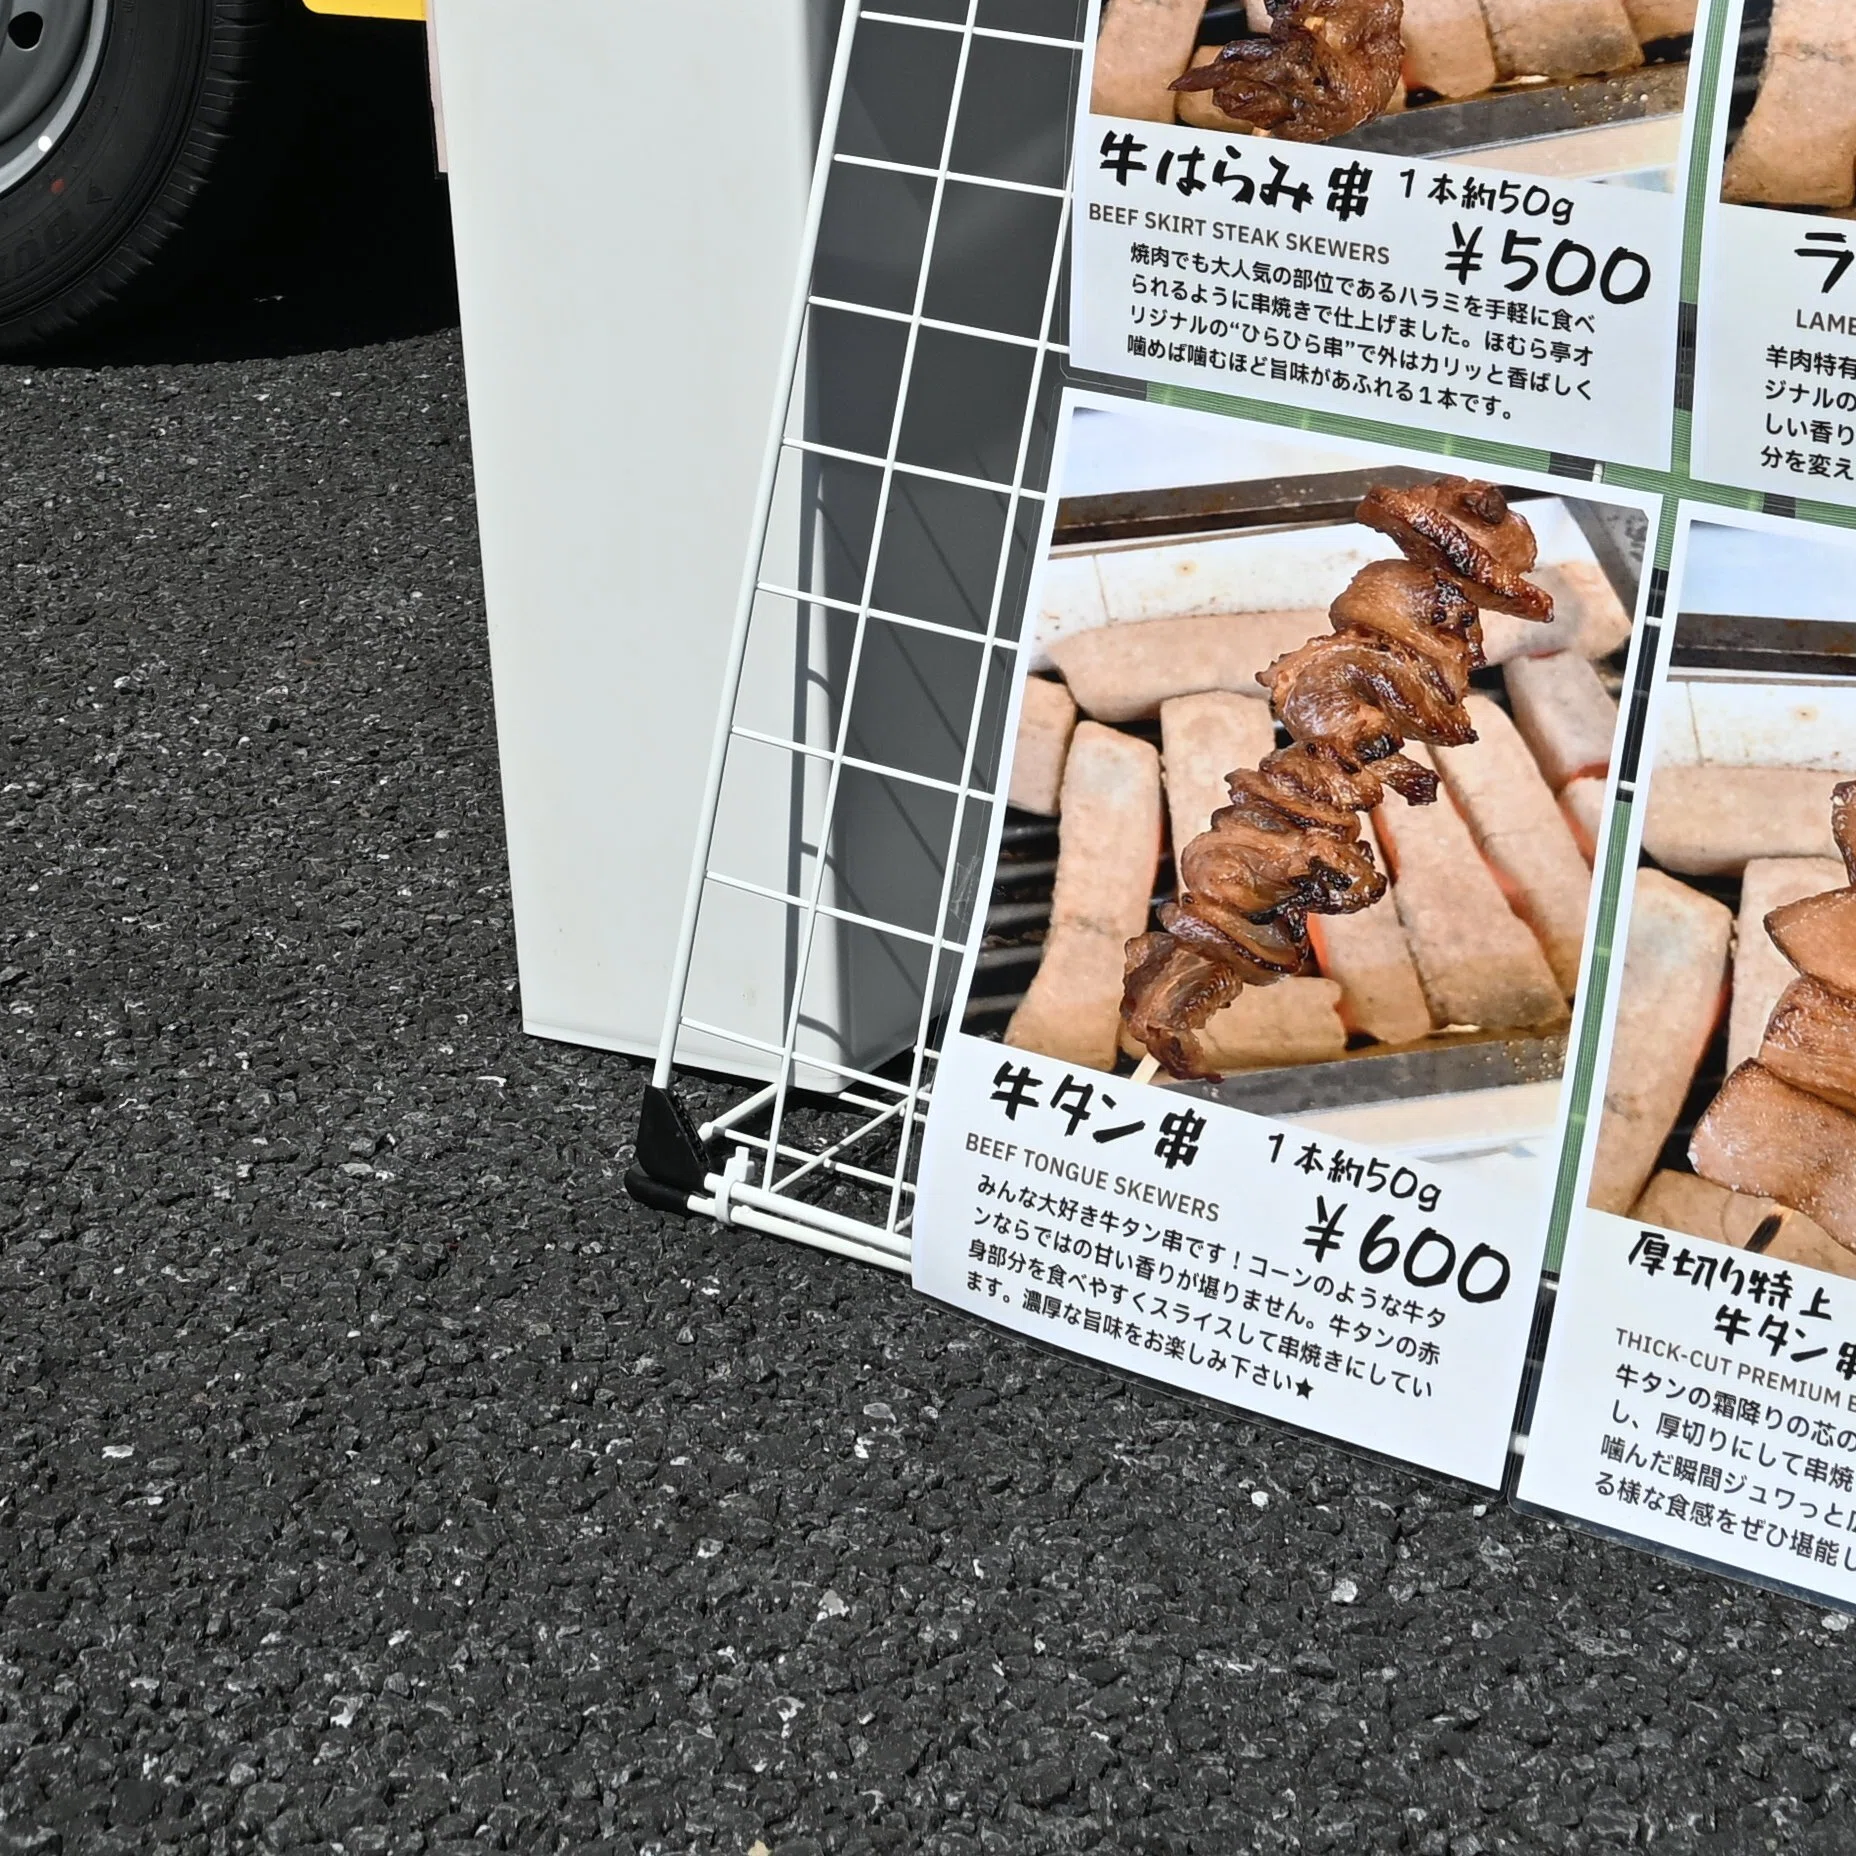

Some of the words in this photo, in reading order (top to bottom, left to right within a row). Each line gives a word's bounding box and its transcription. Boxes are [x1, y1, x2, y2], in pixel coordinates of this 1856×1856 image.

[1099, 129, 1374, 223] 牛はらみ串
[1399, 168, 1575, 226] 1本約50g
[1089, 202, 1139, 226] BEEF
[1144, 211, 1207, 237] SKIRT
[1212, 221, 1280, 249] STEAK
[1285, 232, 1390, 265] SKEWERS
[1444, 220, 1652, 305] ¥500
[1130, 241, 1595, 334] 焼肉でも大人気の部位であるハラミを手軽に食べ
[1131, 273, 1594, 367] られるように串焼きで仕上げました。ほむら亭オ
[989, 1060, 1208, 1170] 牛タン串
[965, 1132, 1018, 1162] BEEF
[1023, 1148, 1109, 1191] TONGUE
[1113, 1176, 1220, 1222] SKEWERS
[1268, 1132, 1442, 1213] 1本約50g
[974, 1206, 1441, 1366] ンならではの甘い香りが堪りません。牛タンの赤
[977, 1173, 1446, 1329] みんな大好き牛タン串です！コーンのような牛タ
[1302, 1194, 1511, 1305] ¥600
[1627, 1230, 1832, 1321] 厚切り特上
[968, 1238, 1432, 1398] 身部分を食べやすくスライスして串焼きにしてい
[1616, 1327, 1733, 1376] THICK-CUT
[1737, 1362, 1841, 1408] PREMIUM
